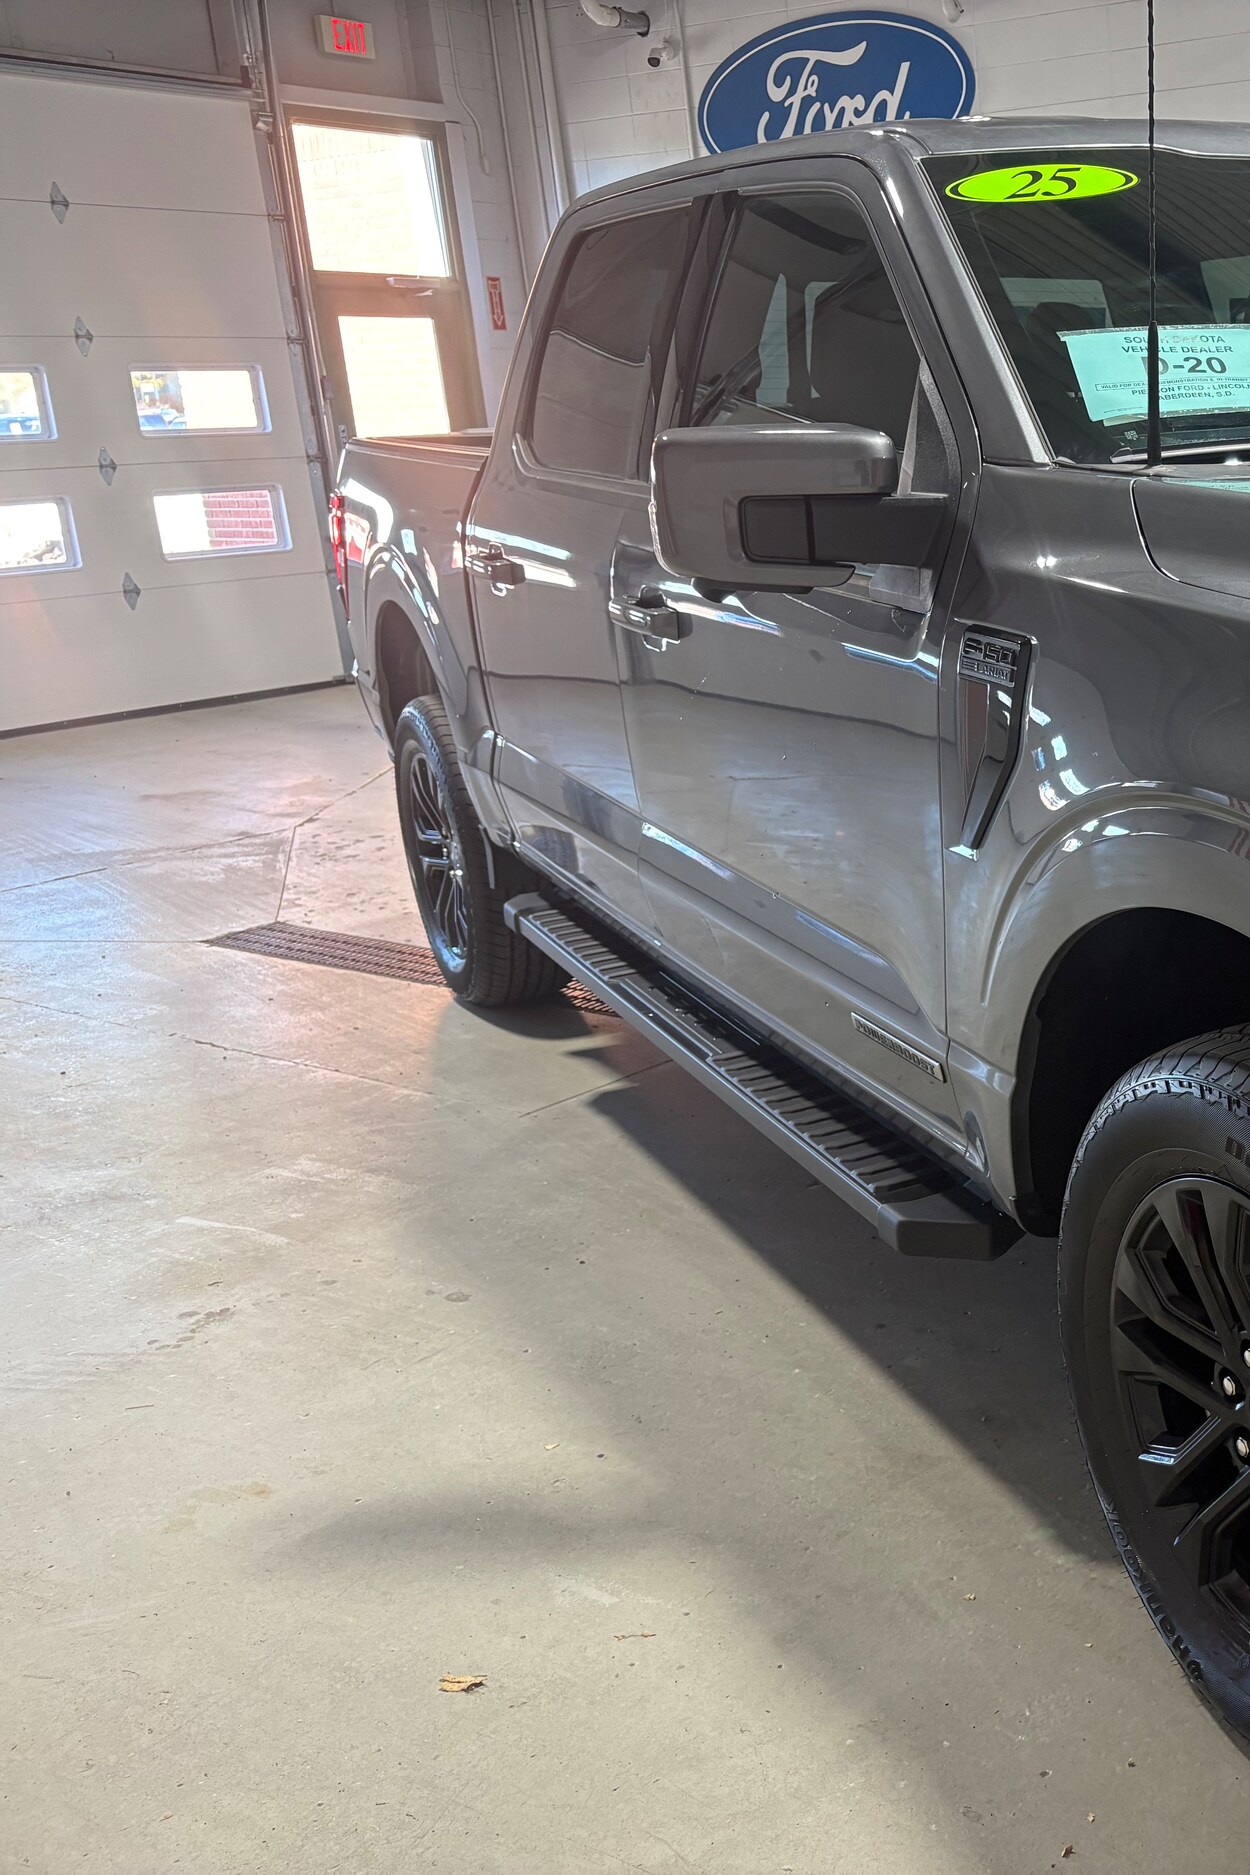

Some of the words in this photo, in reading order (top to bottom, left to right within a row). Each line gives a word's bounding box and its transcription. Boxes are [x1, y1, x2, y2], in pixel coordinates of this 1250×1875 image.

[331, 18, 366, 55] EXIT
[757, 41, 910, 144] Ford
[1003, 167, 1082, 200] 25
[1131, 387, 1175, 395] PIEON
[976, 662, 1009, 680] LARIAT
